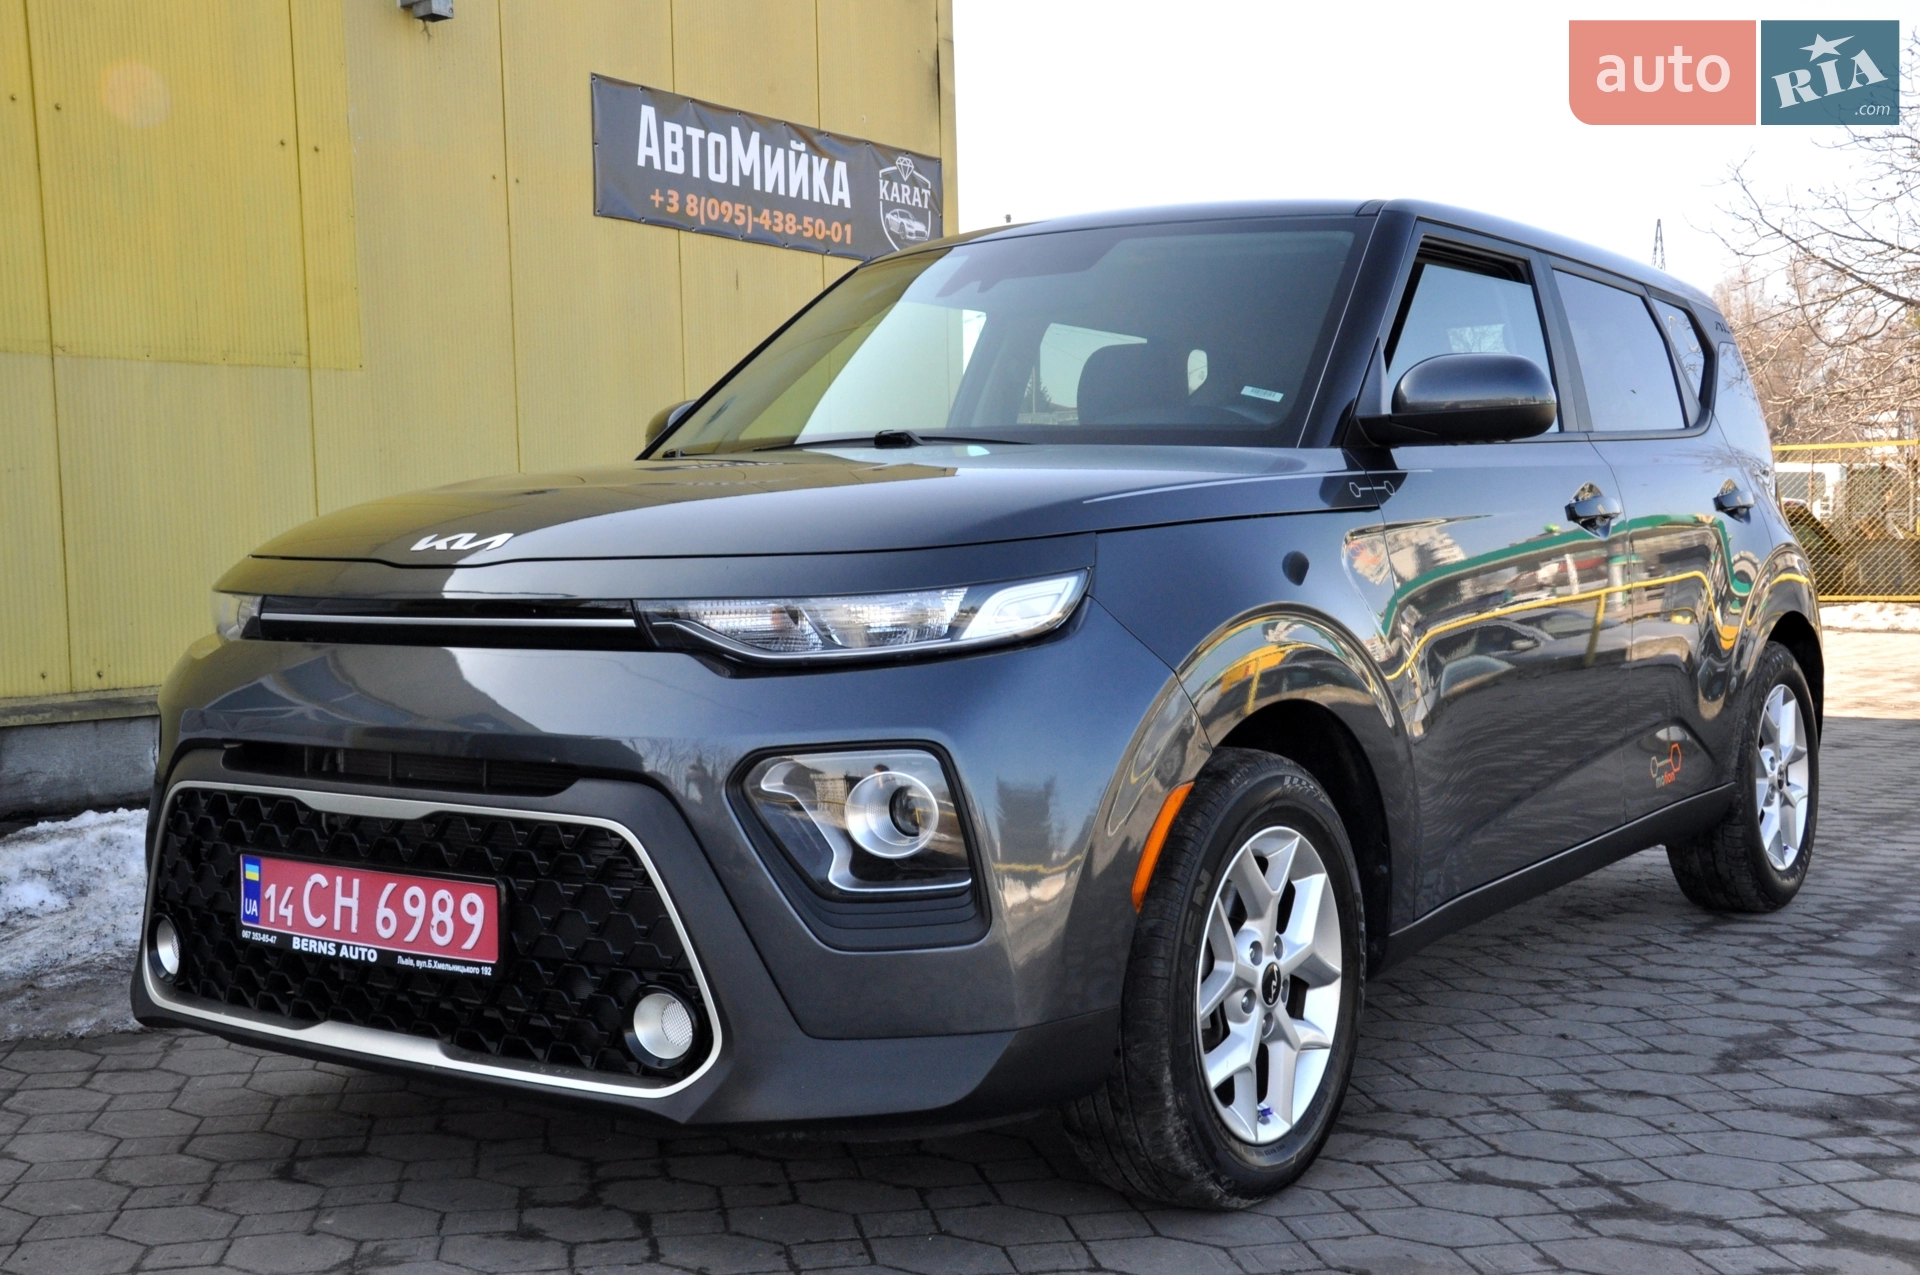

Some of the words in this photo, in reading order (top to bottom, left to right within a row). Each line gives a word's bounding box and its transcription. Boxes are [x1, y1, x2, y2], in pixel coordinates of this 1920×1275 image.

[878, 178, 931, 210] KARAT
[650, 188, 679, 214] +3
[685, 193, 852, 244] 8(095)-438-50-01
[410, 532, 514, 552] KIA
[244, 898, 258, 917] UA
[264, 883, 294, 927] 14
[376, 883, 484, 950] 6989
[241, 929, 251, 939] 067
[292, 936, 337, 956] BERNS
[339, 944, 378, 963] AUTO
